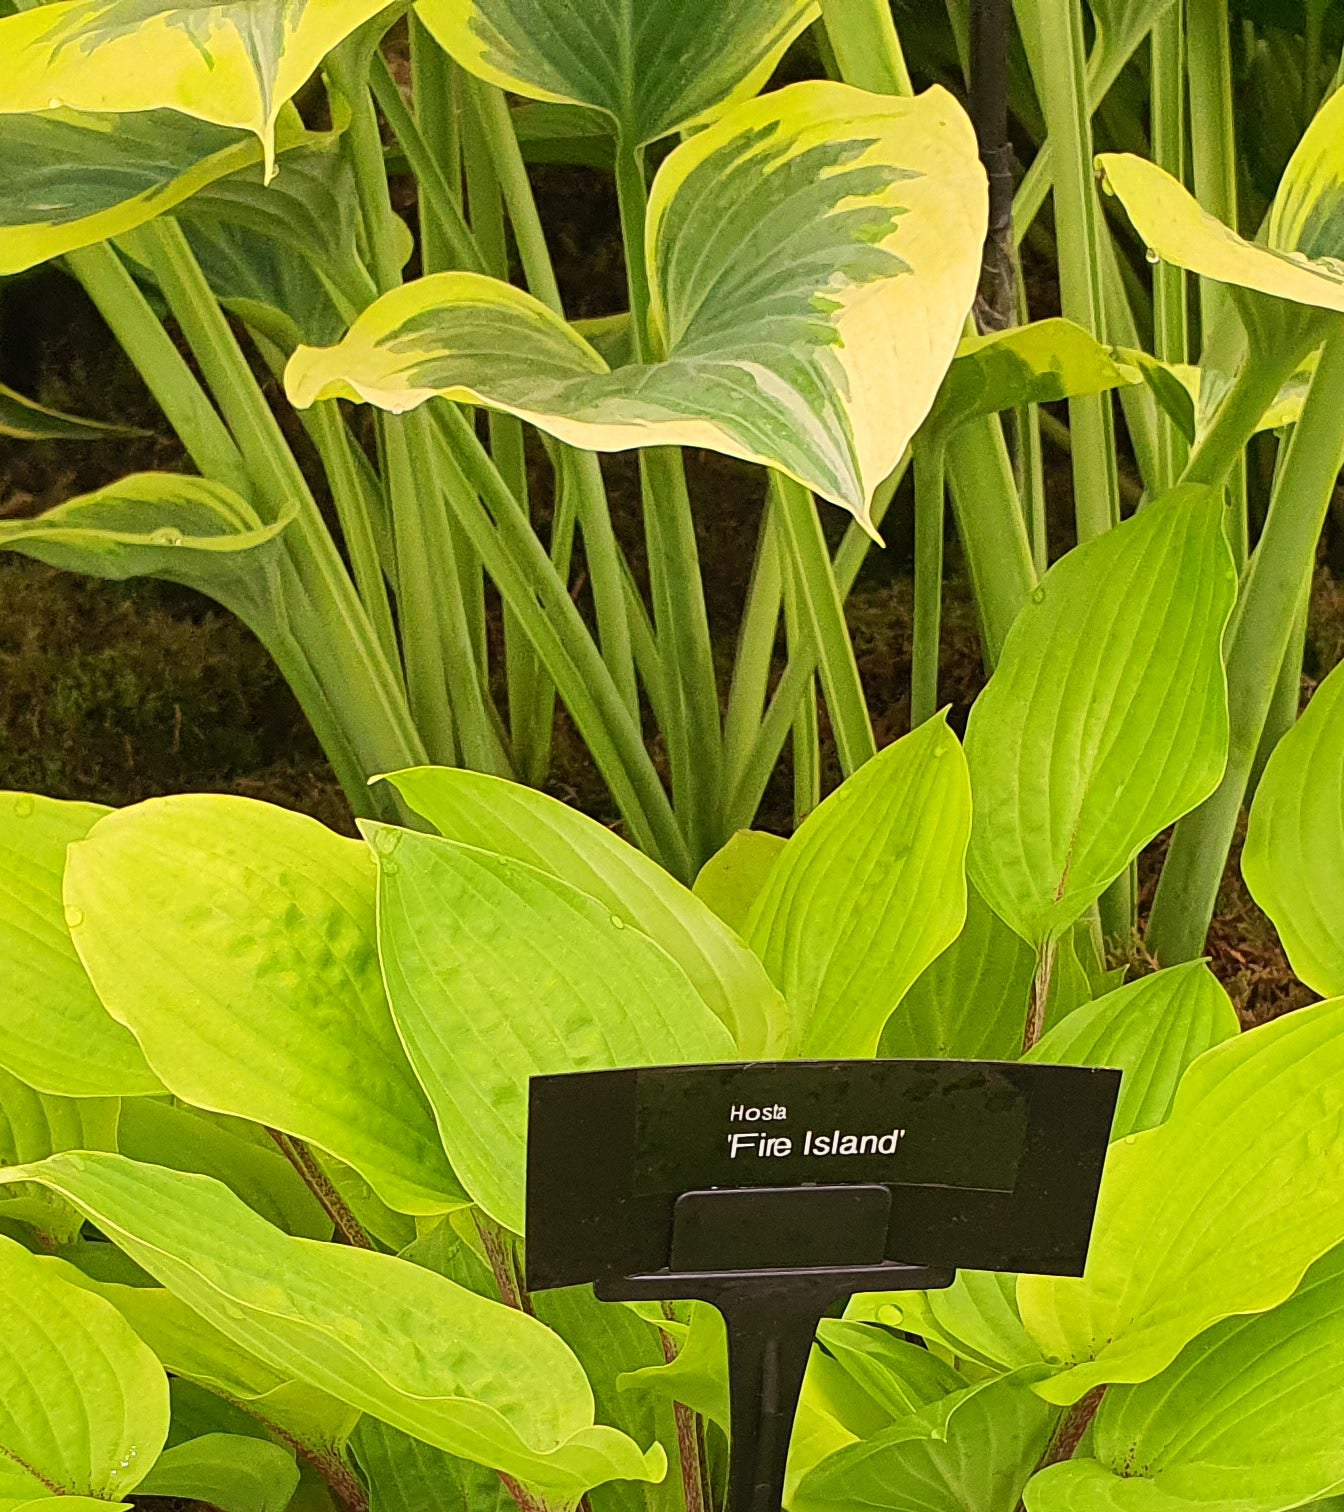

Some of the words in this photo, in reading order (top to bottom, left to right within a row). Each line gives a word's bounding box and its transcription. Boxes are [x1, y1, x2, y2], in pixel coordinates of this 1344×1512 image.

[729, 1103, 788, 1122] Hosta
[727, 1132, 793, 1159] 'Fire
[803, 1128, 906, 1157] Island'
